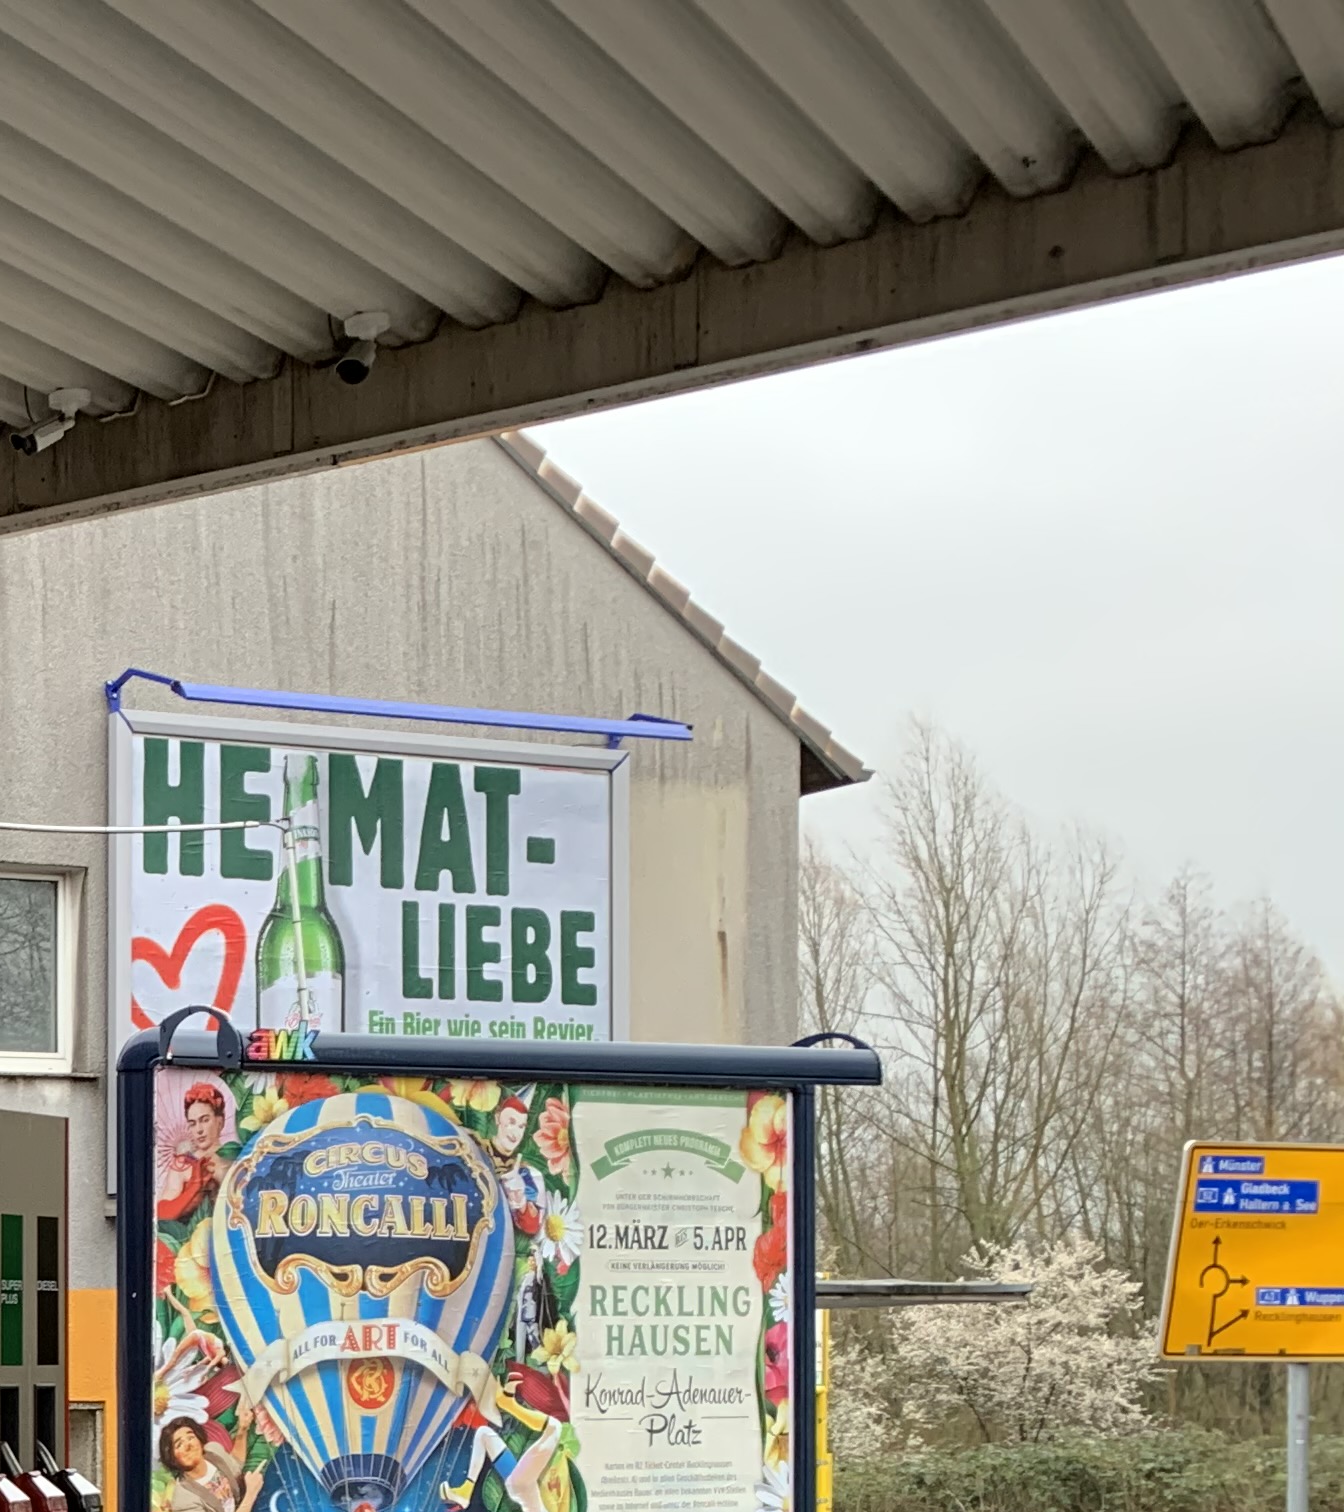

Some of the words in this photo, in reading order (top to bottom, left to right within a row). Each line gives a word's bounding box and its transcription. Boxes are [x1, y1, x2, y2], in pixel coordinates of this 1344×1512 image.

[401, 900, 598, 1006] LIEBE
[368, 1009, 396, 1035] Ein
[403, 1011, 441, 1036] Bier
[446, 1013, 482, 1038] wie
[489, 1015, 527, 1039] sein
[247, 1020, 320, 1061] awk
[614, 1135, 653, 1157] KOMPLETT
[653, 1134, 678, 1146] NEUES
[303, 1140, 428, 1181] CIRCUS
[1219, 1159, 1262, 1171] Münster
[331, 1169, 398, 1191] Theater
[1240, 1183, 1290, 1195] Gladbeck
[255, 1190, 471, 1242] RONCALLI
[1239, 1199, 1279, 1210] Haltern
[1295, 1199, 1317, 1211] See
[1190, 1218, 1286, 1230] Oer-Erkenschwick
[633, 1261, 690, 1271] VERLÄNGERUNG
[692, 1261, 725, 1271] MÖGLICH!
[1, 1279, 23, 1291] SUPER
[37, 1280, 59, 1291] DIESEL
[0, 1293, 19, 1305] PLUS
[589, 1285, 751, 1317] RECKLING
[1254, 1311, 1342, 1324] Recklinghausen
[292, 1343, 311, 1360] ALL
[313, 1334, 337, 1349] FOR
[340, 1323, 401, 1353] ART
[403, 1331, 428, 1353] FOR
[431, 1350, 450, 1374] ALL
[605, 1324, 734, 1356] HAUSEN
[585, 1368, 751, 1414] Konrad-Adenauer-
[639, 1413, 702, 1447] Platz
